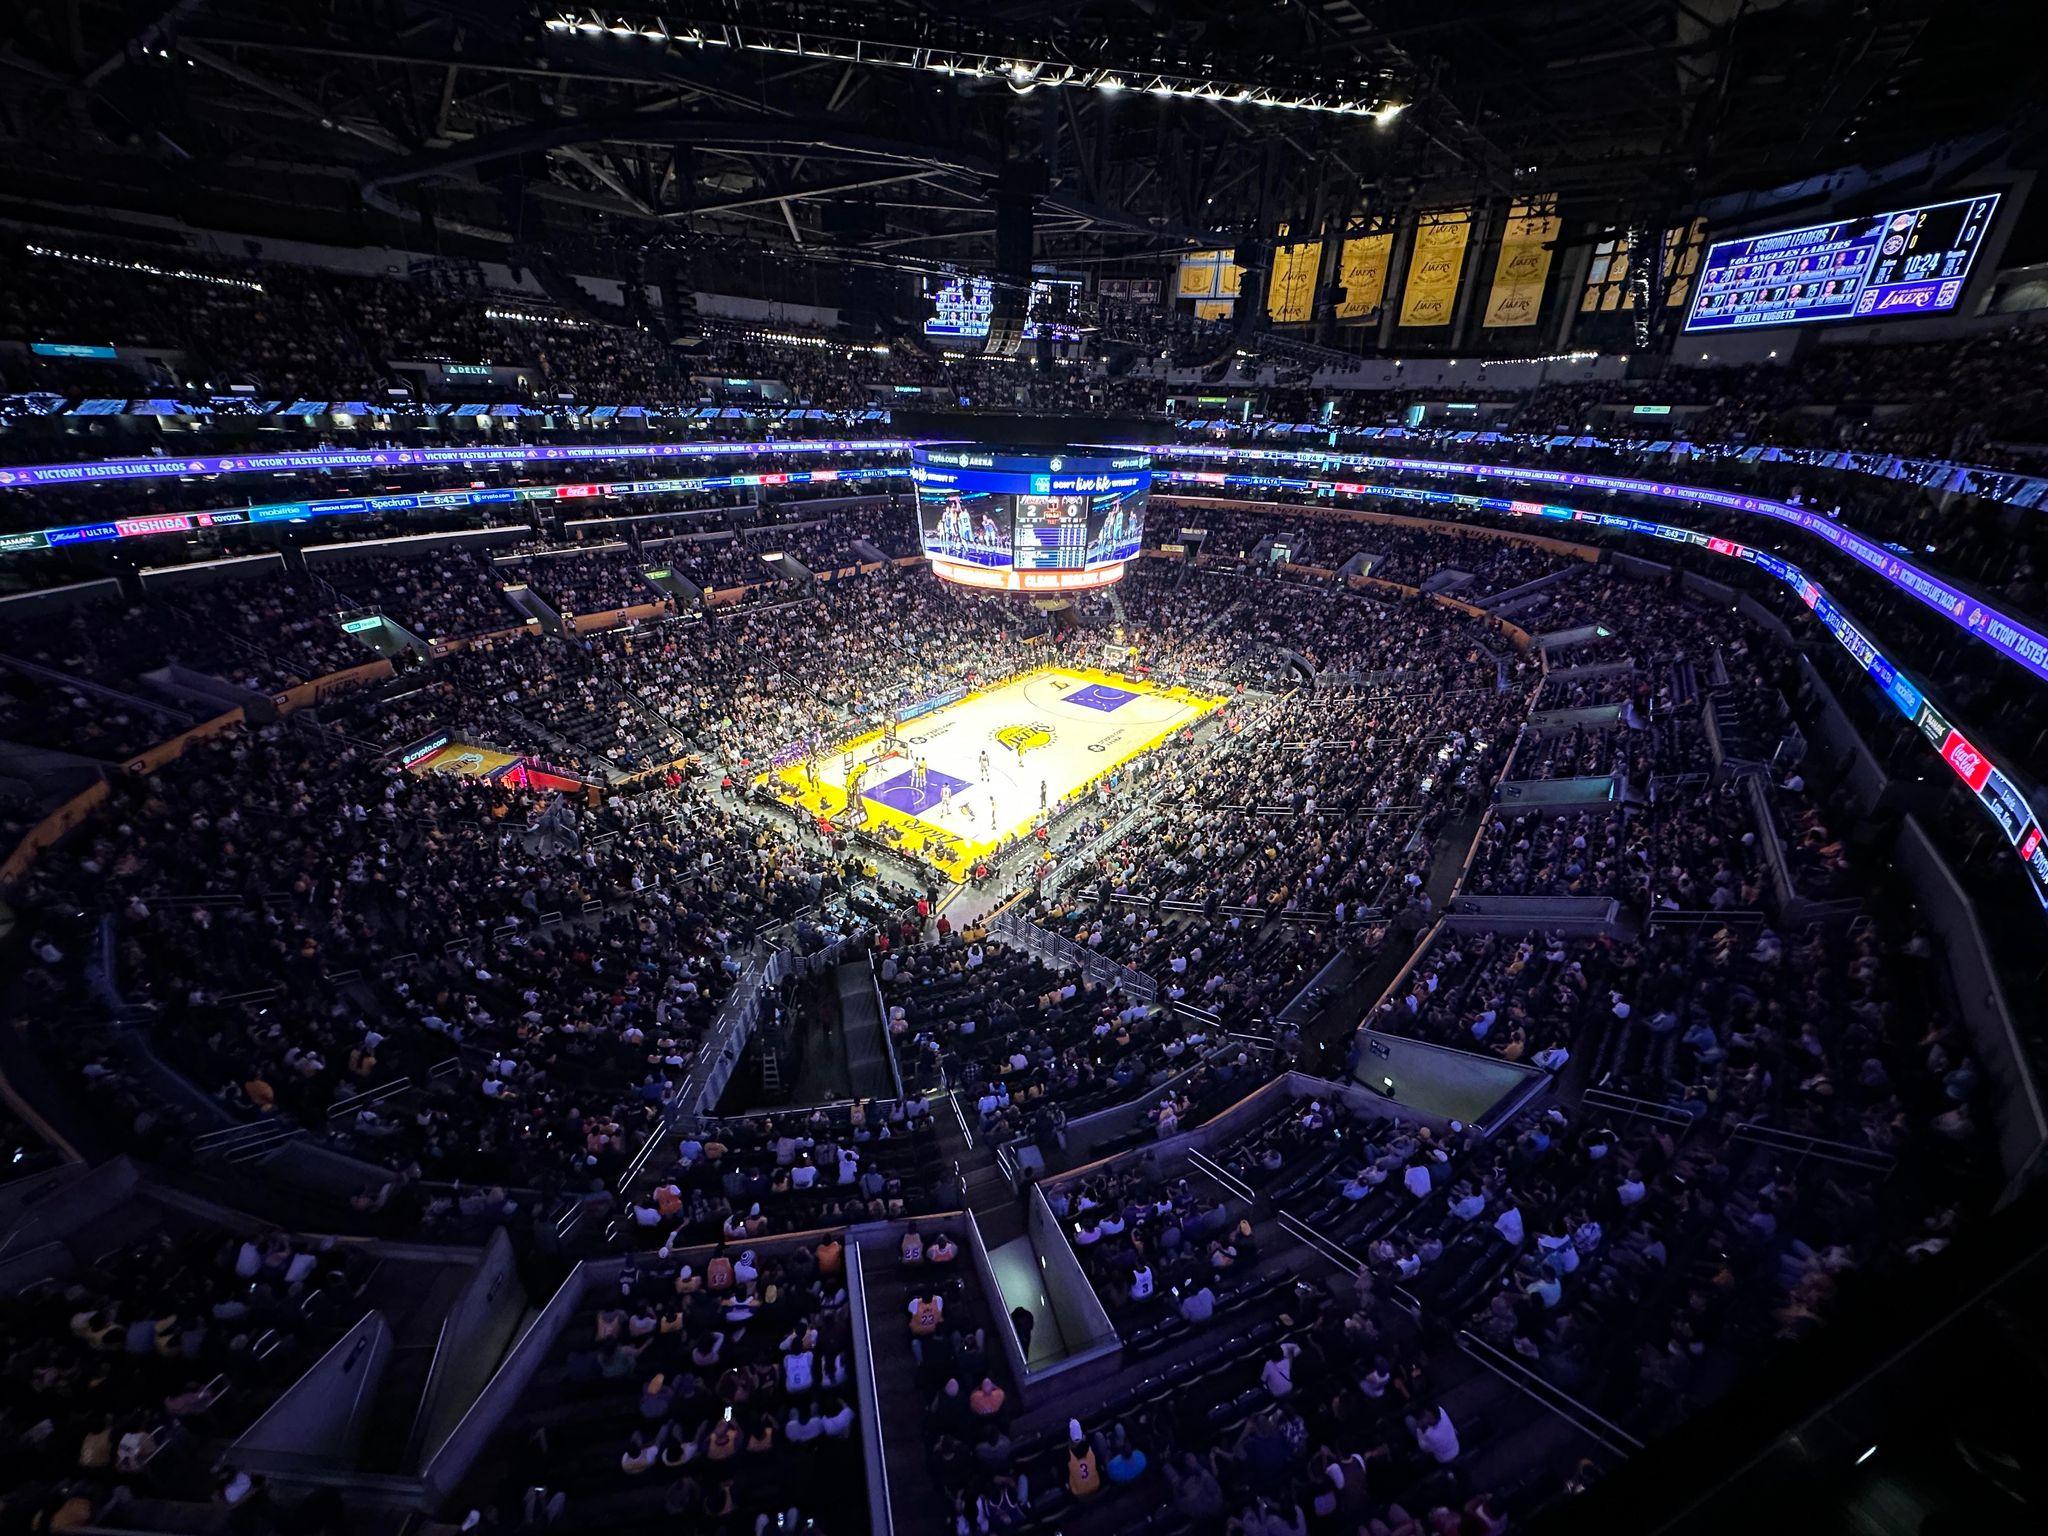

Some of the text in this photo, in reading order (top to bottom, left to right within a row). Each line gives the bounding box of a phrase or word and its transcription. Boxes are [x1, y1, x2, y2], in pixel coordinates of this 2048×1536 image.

[1974, 202, 1986, 219] 2
[1917, 214, 1927, 228] 2
[1965, 226, 1977, 241] 0
[1754, 229, 1829, 252] SCORING LEADERS
[1908, 235, 1918, 249] 0
[1799, 240, 1852, 255] LAKERS
[1818, 256, 1830, 270] 13
[1855, 250, 1865, 264] 9
[1904, 253, 1941, 273] 10:24
[1421, 261, 1451, 274] LAKERS
[1751, 265, 1764, 278] 23
[1780, 261, 1794, 275] 23
[1807, 283, 1820, 297] 15
[1841, 279, 1856, 293] 14
[1712, 295, 1725, 307] 37
[1774, 288, 1785, 301] 17
[1877, 291, 1934, 309] LAKERS
[1413, 300, 1442, 312] LAKERS
[1498, 299, 1530, 311] LAKERS
[1734, 309, 1795, 324] DENVER NUGGETS
[458, 366, 488, 374] DELTA
[424, 450, 525, 461] VICTORY TASTES LIKE TACOS
[566, 449, 593, 457] VICTORY
[248, 455, 372, 468] VICTORY TASTES LIKE TACOS
[928, 454, 993, 467] crypto.com ARENA
[33, 463, 186, 480] VICTORY TASTES LIKE TACOS
[1076, 476, 1096, 492] live
[434, 496, 456, 504] 5:43
[481, 492, 510, 501] crypto.com
[371, 498, 412, 510] Spectrum
[1067, 504, 1077, 517] 0
[1512, 503, 1542, 514] TOSHIBA
[259, 507, 300, 517] mobilitie
[1027, 505, 1037, 517] 2
[212, 514, 242, 523] TOYOTA
[1603, 516, 1629, 527] Spectrum
[86, 526, 116, 537] ULTRA
[118, 518, 185, 534] TOSHIBA
[1664, 529, 1679, 539] 5:43
[1986, 618, 2019, 648] VICTORY
[2015, 634, 2045, 665] TASTES
[997, 724, 1055, 751] LAKERS
[410, 737, 448, 760] crypto.com
[1080, 1463, 1089, 1480] 3
